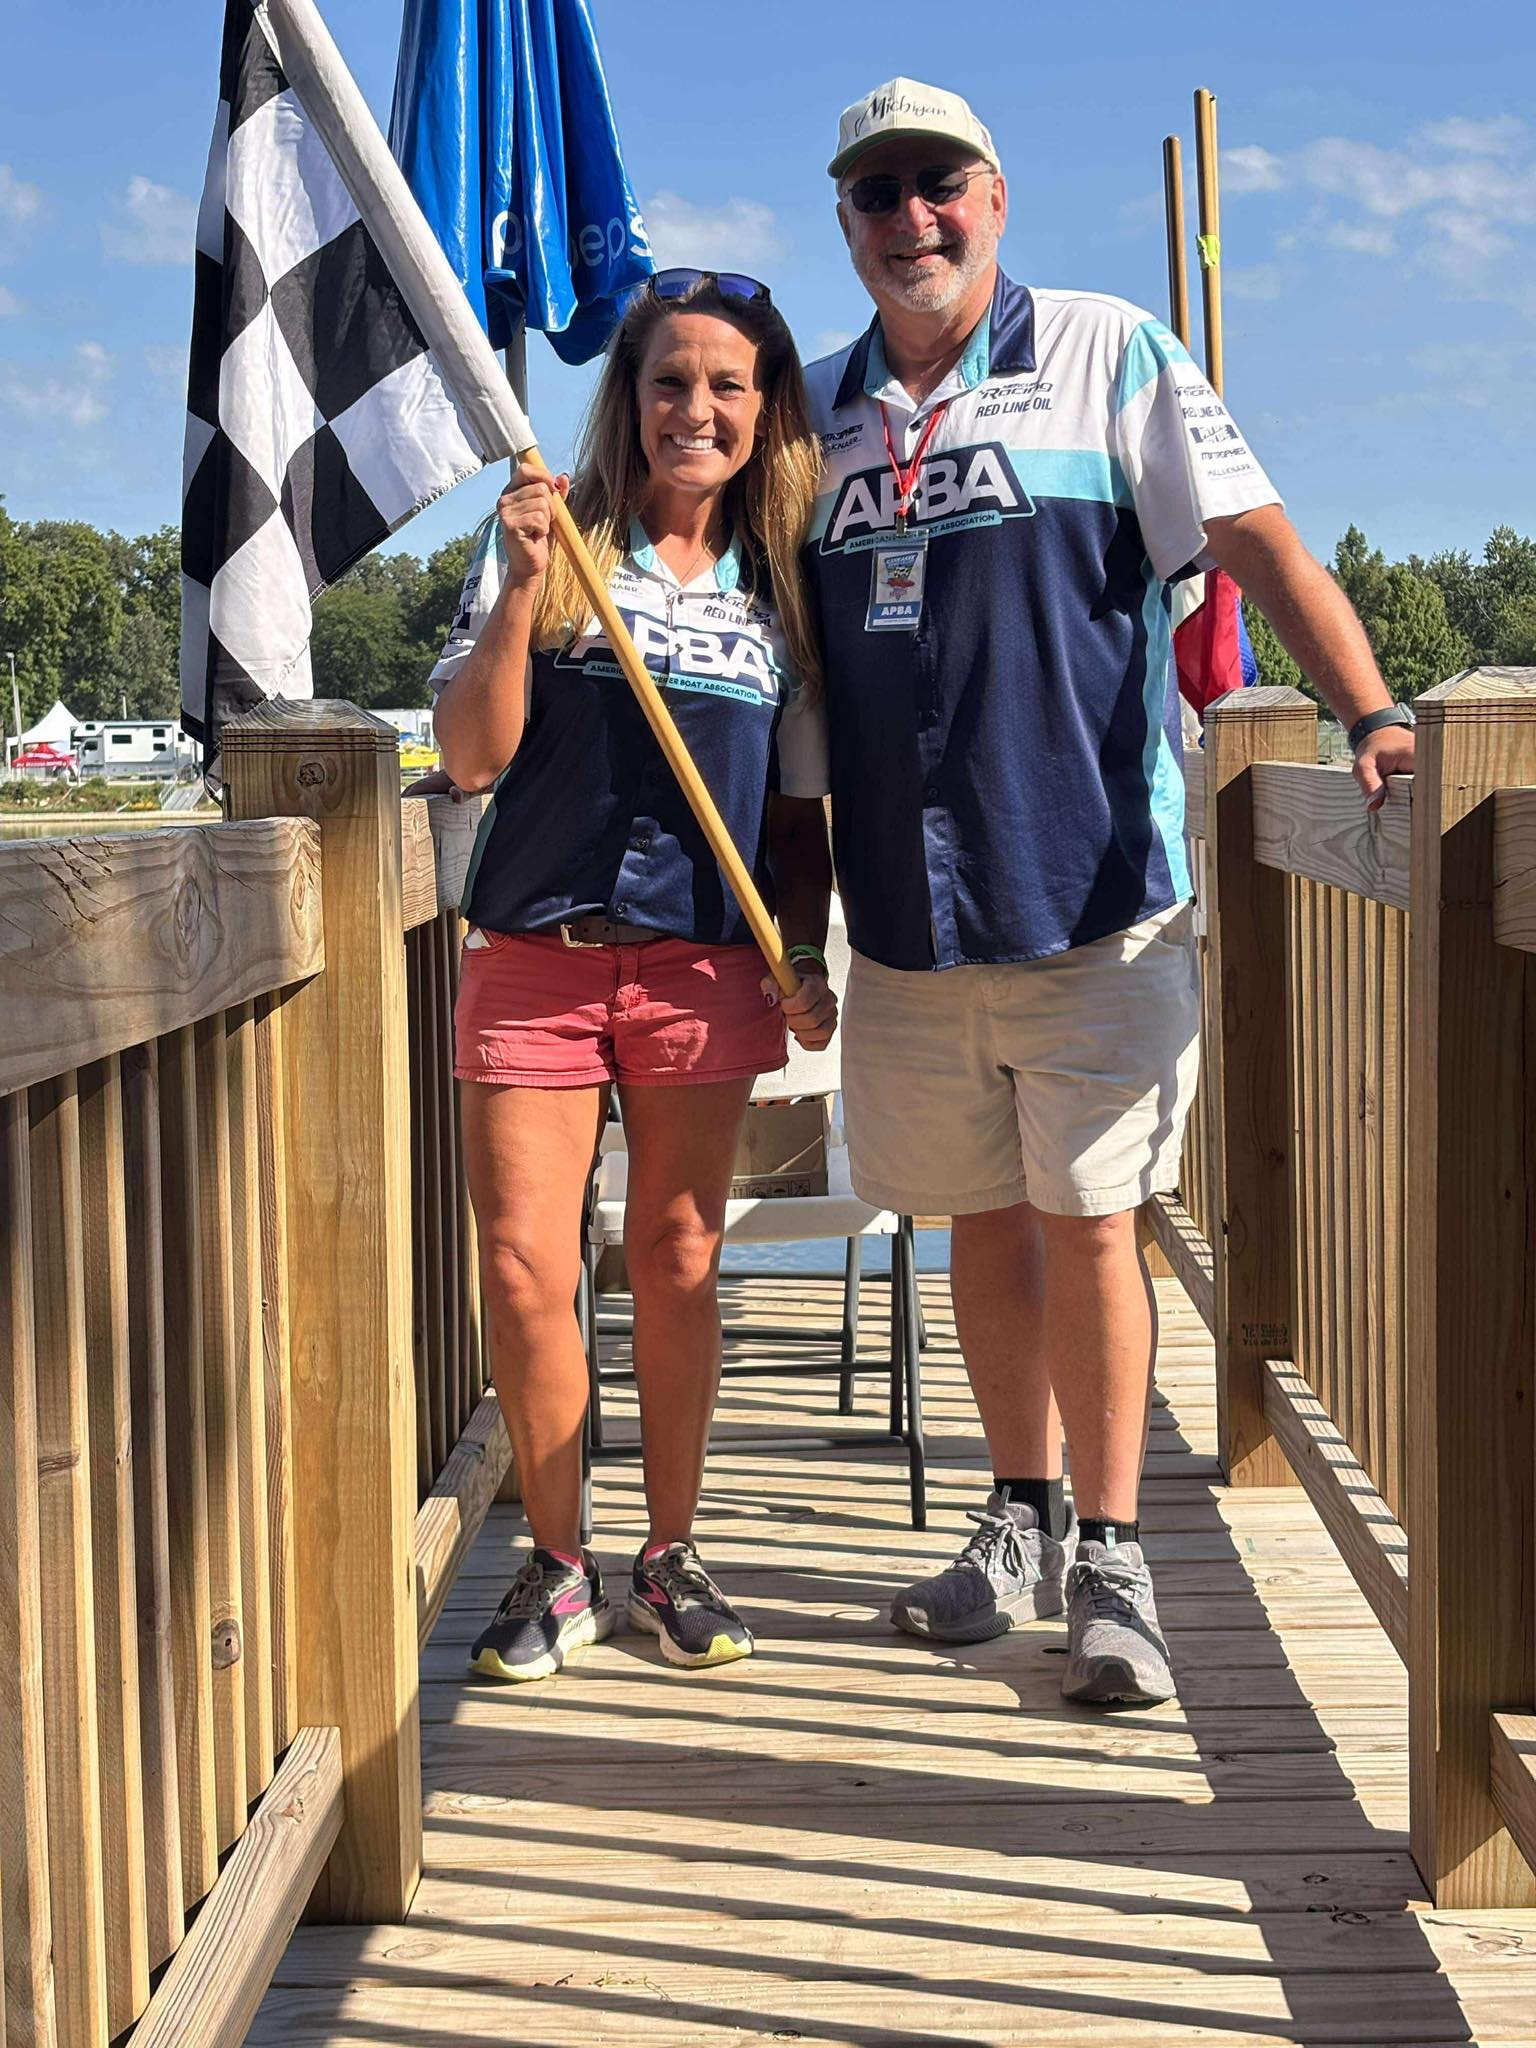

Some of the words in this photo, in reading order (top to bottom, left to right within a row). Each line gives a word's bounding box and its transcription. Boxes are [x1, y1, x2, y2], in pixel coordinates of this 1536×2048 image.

[855, 95, 946, 137] Michigan
[975, 404, 1000, 419] RED
[1002, 400, 1031, 414] LINE
[1033, 397, 1053, 411] OIL
[830, 449, 1018, 543] APBA
[940, 514, 996, 531] ASSOCIATION
[703, 605, 726, 620] RED
[729, 612, 753, 627] LINE
[881, 605, 913, 616] APBA
[590, 664, 625, 676] AMERIC
[680, 678, 702, 689] BOAT
[704, 683, 758, 700] ASSOCIATION
